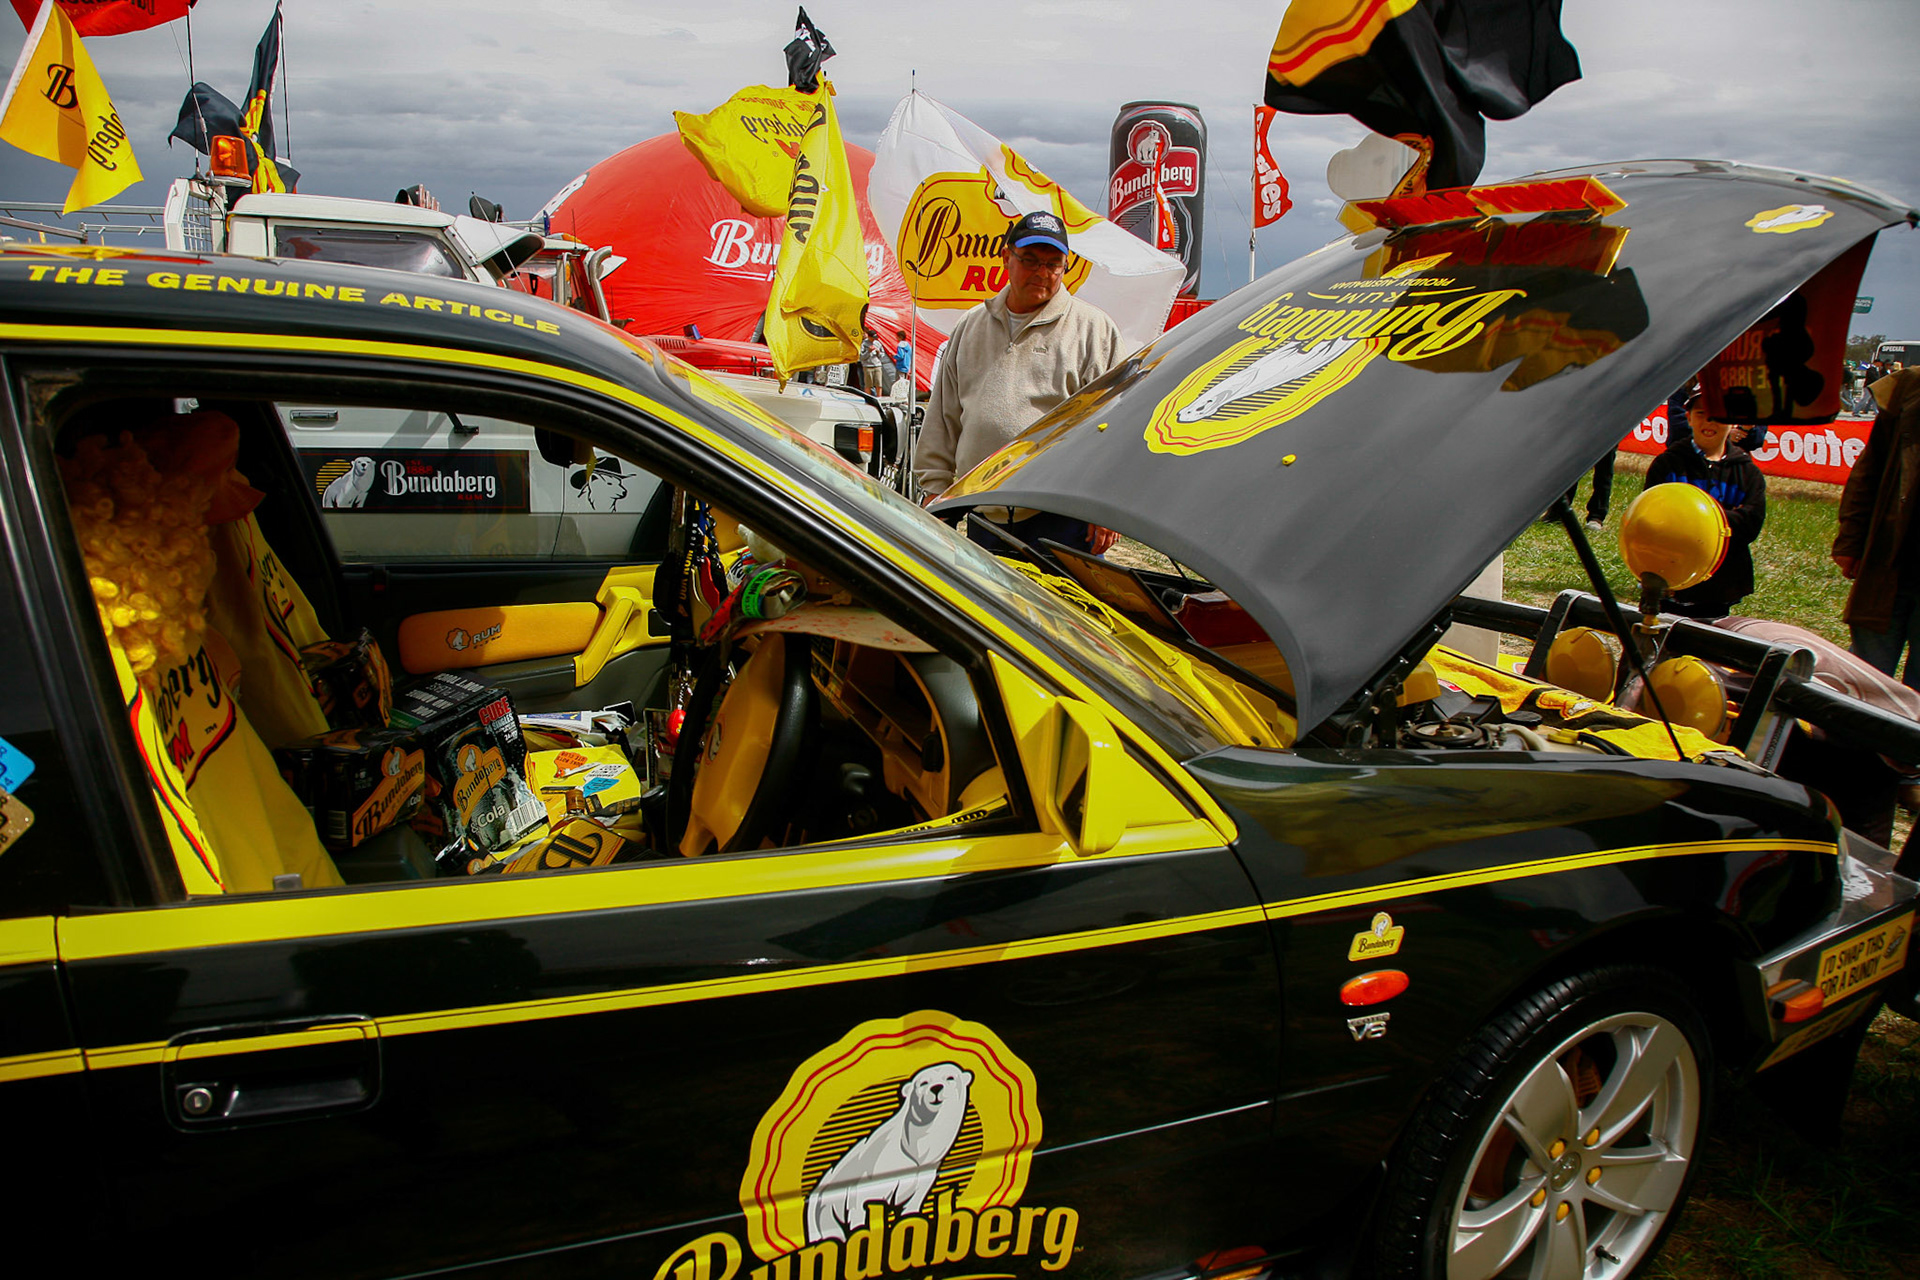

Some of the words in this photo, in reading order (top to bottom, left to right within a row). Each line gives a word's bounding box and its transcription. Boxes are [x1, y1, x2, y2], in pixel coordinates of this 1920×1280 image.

[1336, 290, 1408, 304] RUM
[1398, 277, 1457, 288] PROUDLY
[28, 265, 129, 286] THE
[147, 272, 366, 302] GENUINE
[380, 292, 561, 336] ARTICLE
[1237, 289, 1528, 362] Bundaberg
[1634, 416, 1668, 444] co
[1750, 428, 1868, 469] coate
[380, 460, 496, 499] Bundaberg
[473, 622, 501, 645] RUM
[478, 695, 513, 727] CUBE
[354, 760, 424, 838] Bundaberg
[456, 758, 502, 813] Bundaberg
[477, 803, 506, 829] Cola
[1358, 937, 1396, 953] Bundaberg
[1837, 941, 1864, 970] SWAP
[1864, 931, 1887, 957] THIS
[1847, 954, 1882, 987] BUNDY
